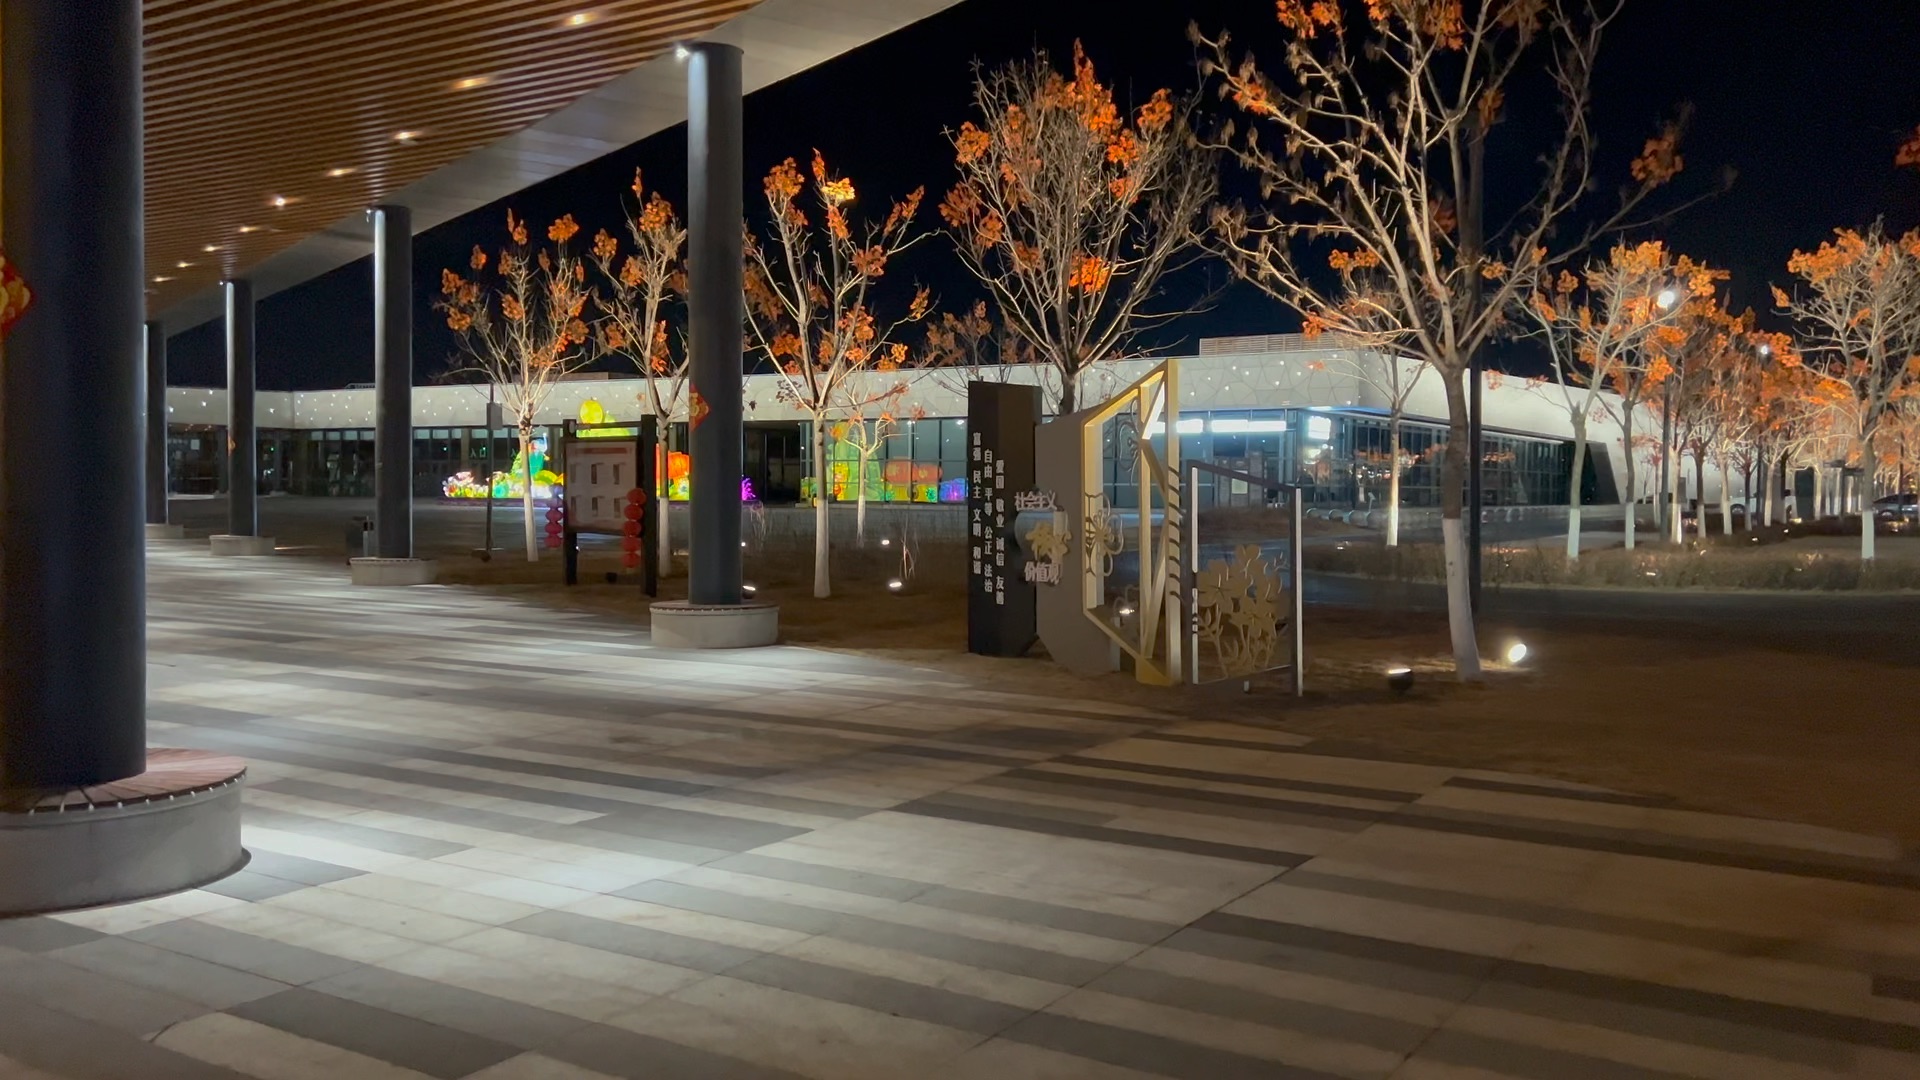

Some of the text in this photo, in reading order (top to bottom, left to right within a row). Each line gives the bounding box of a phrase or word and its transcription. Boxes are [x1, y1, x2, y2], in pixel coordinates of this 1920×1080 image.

[1014, 490, 1058, 512] 社会主义
[1024, 561, 1060, 586] 价值观
